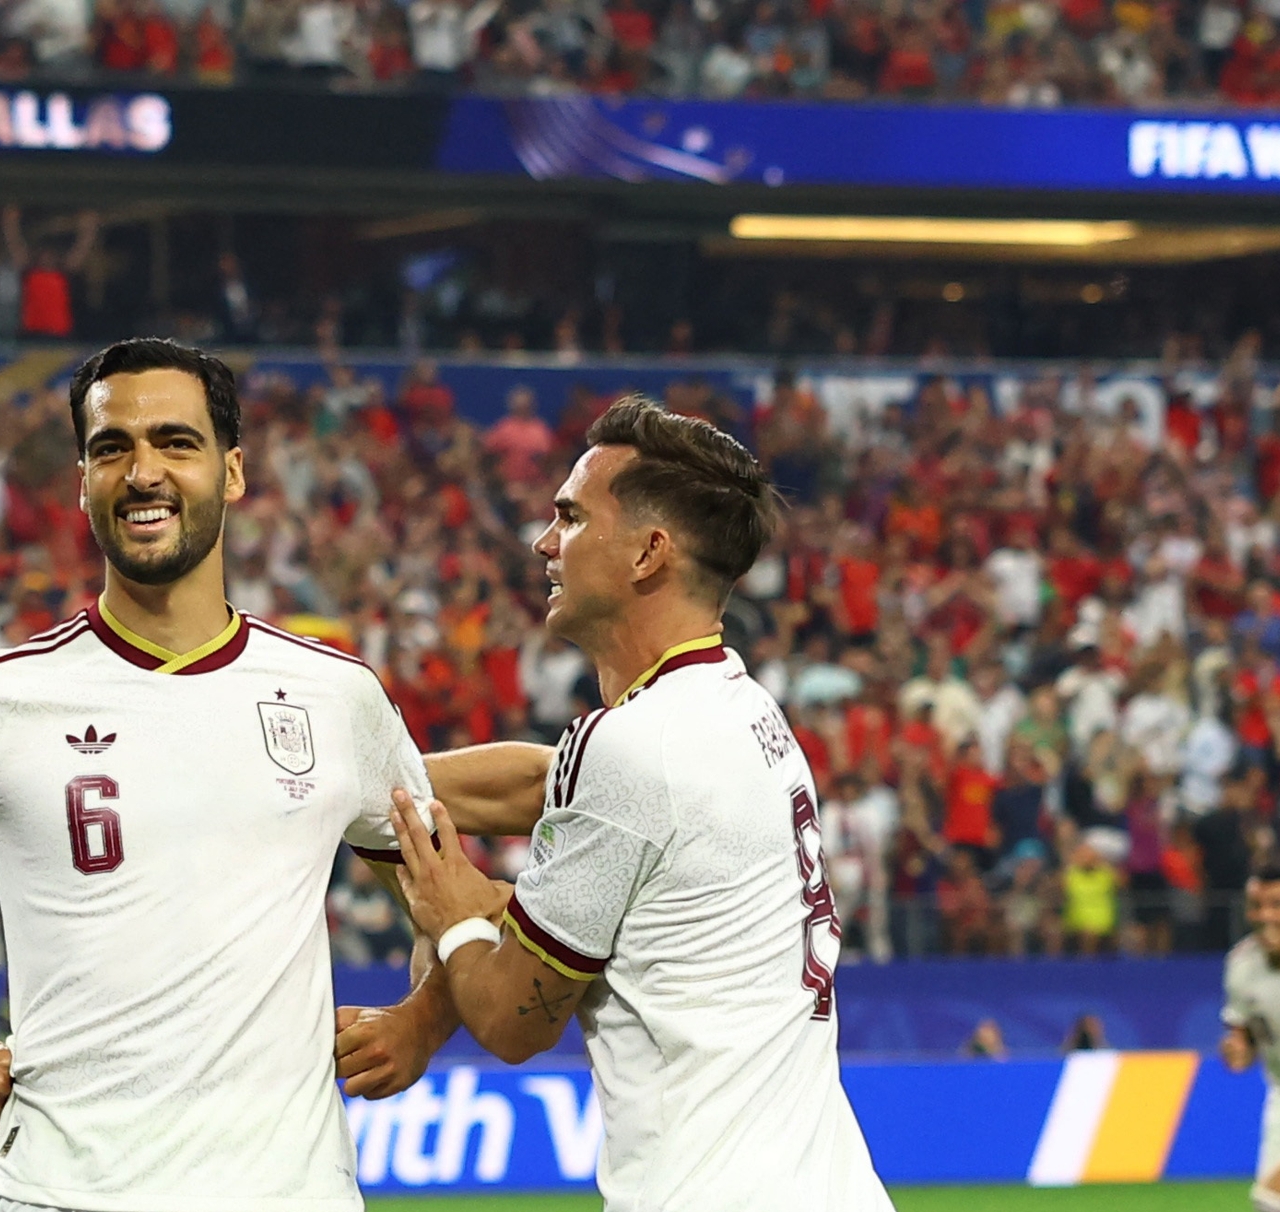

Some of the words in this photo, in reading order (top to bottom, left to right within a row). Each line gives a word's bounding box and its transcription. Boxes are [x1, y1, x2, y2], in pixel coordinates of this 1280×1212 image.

[1127, 120, 1249, 180] FIFA
[65, 774, 125, 875] 6
[790, 784, 843, 1022] 8
[346, 1065, 517, 1187] ith
